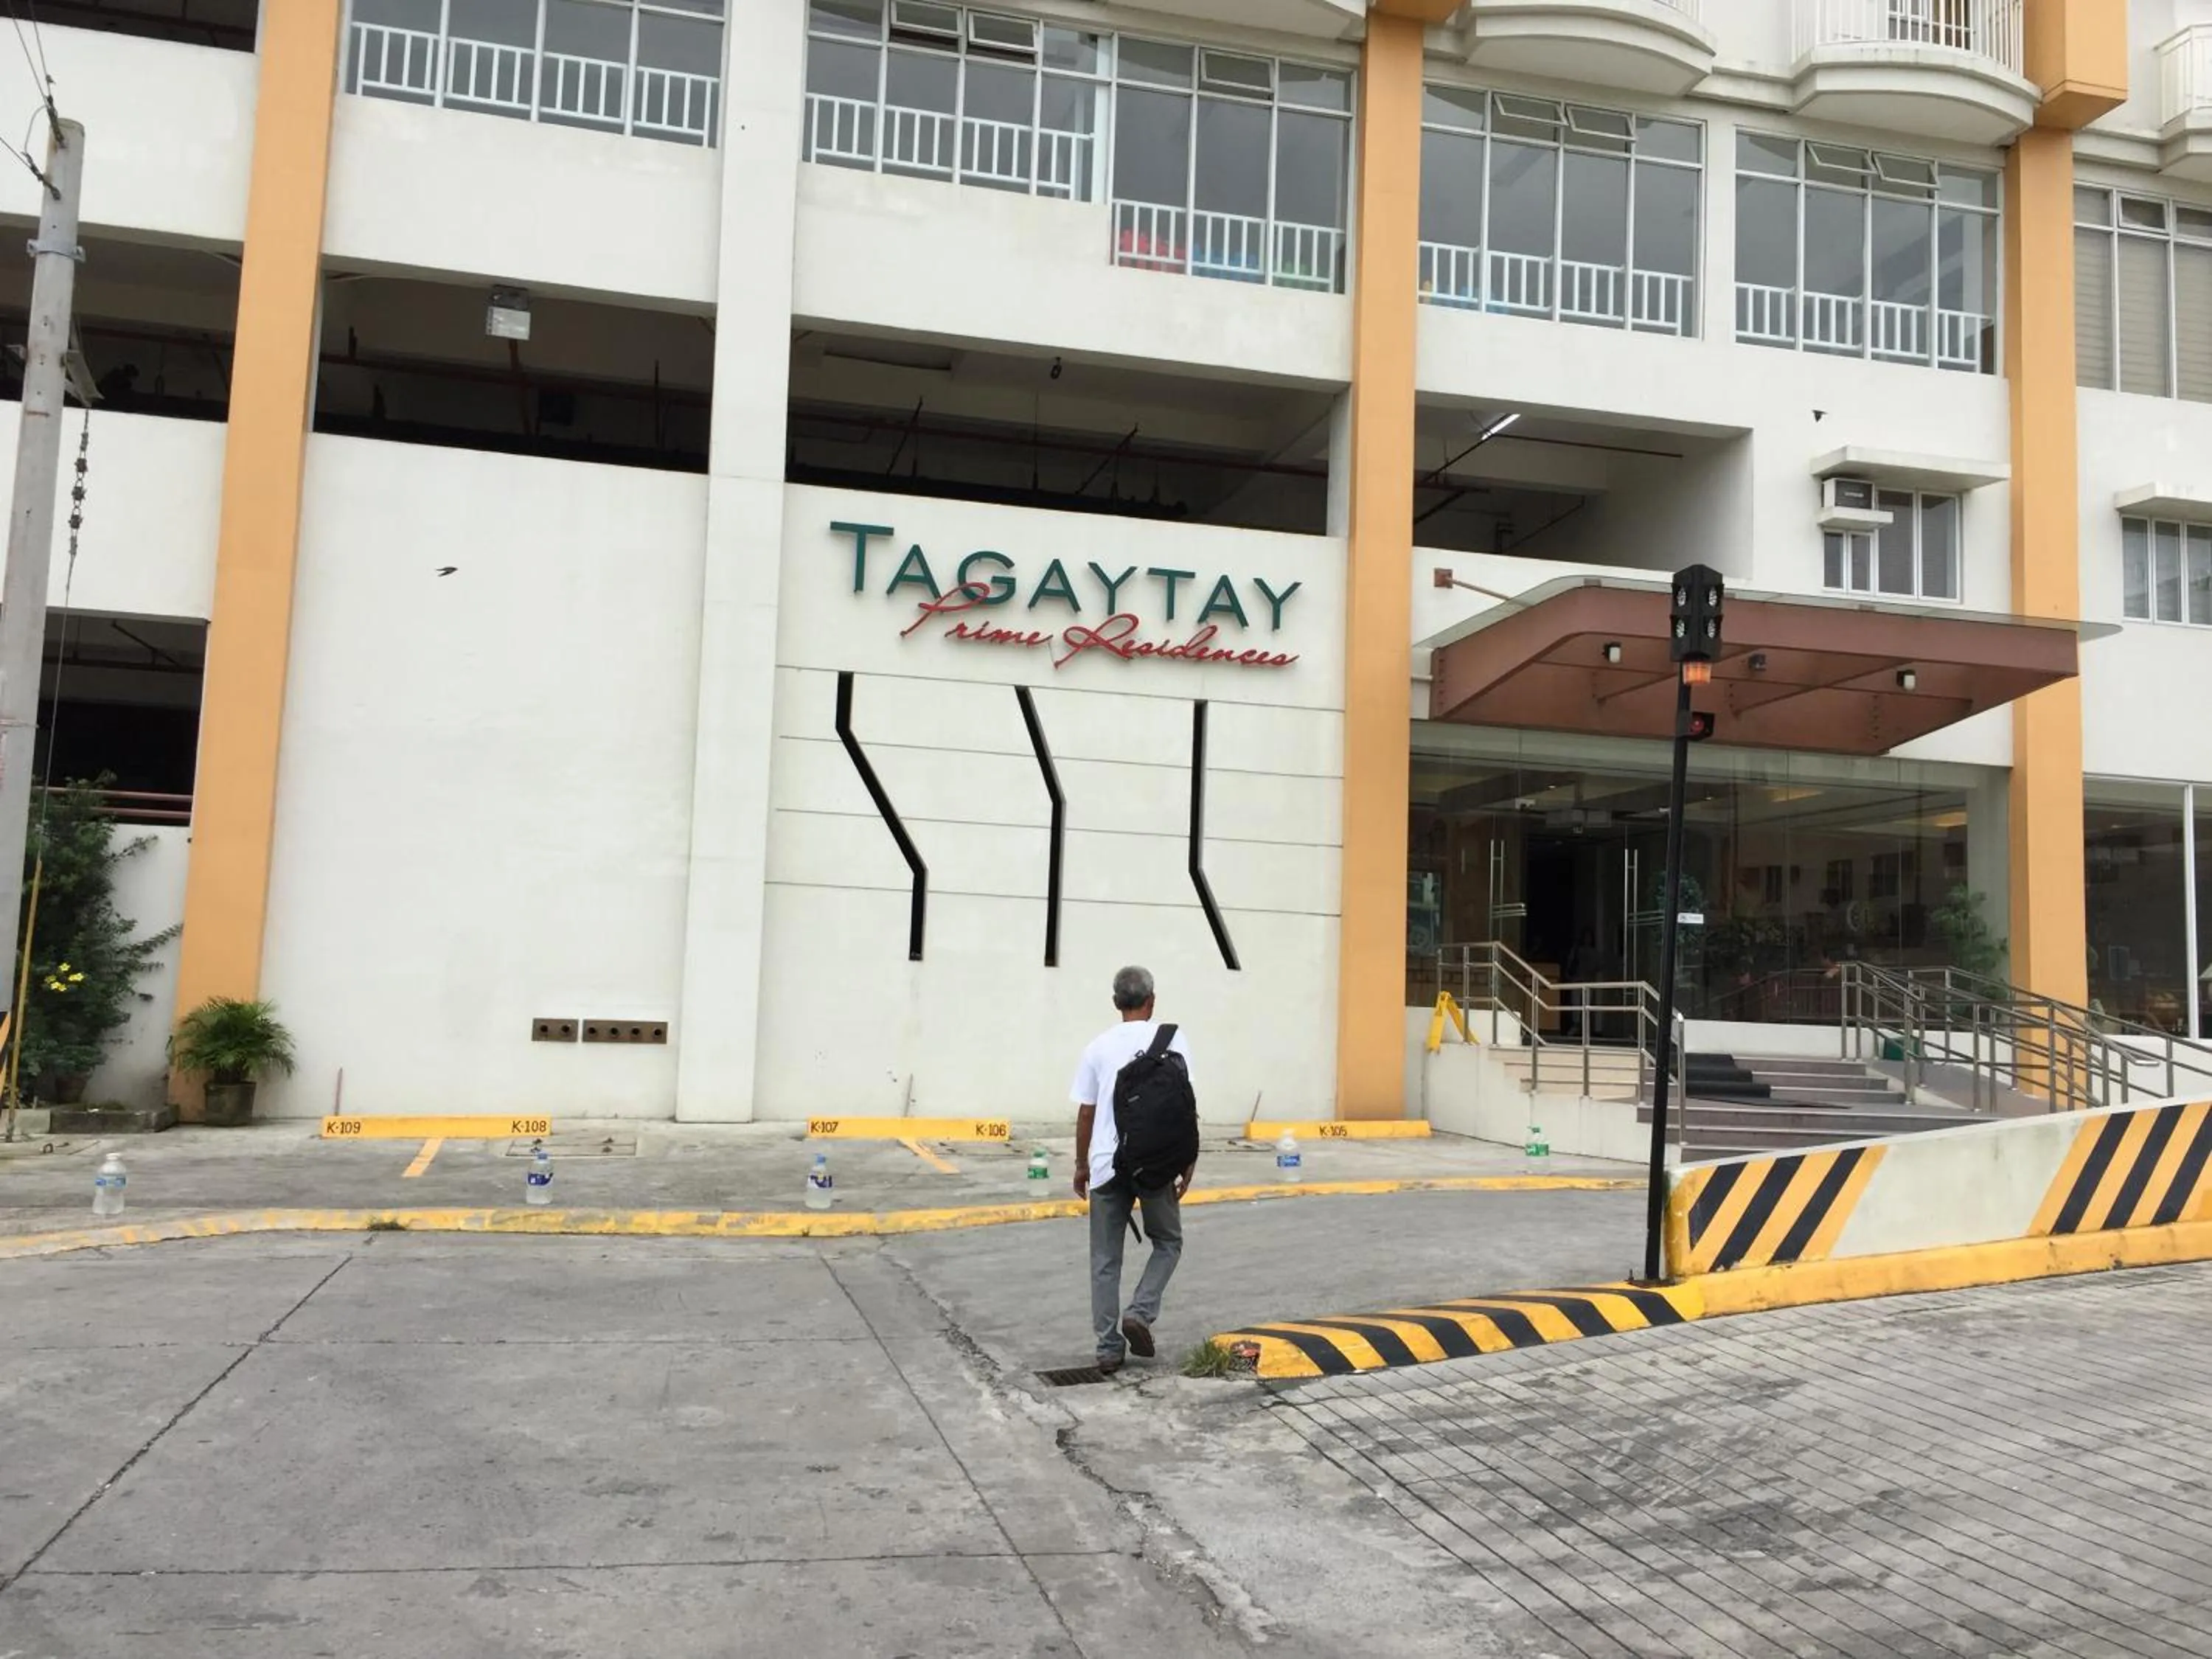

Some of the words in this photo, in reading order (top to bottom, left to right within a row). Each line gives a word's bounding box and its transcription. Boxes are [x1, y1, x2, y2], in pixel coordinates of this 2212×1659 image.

[830, 521, 1303, 630] TAGAYTAY
[900, 582, 1053, 646] Prime
[1053, 613, 1300, 669] Residences
[327, 1121, 361, 1135] K-109
[512, 1120, 547, 1133] K-108
[810, 1121, 839, 1134] K-107
[975, 1123, 1006, 1137] K-106
